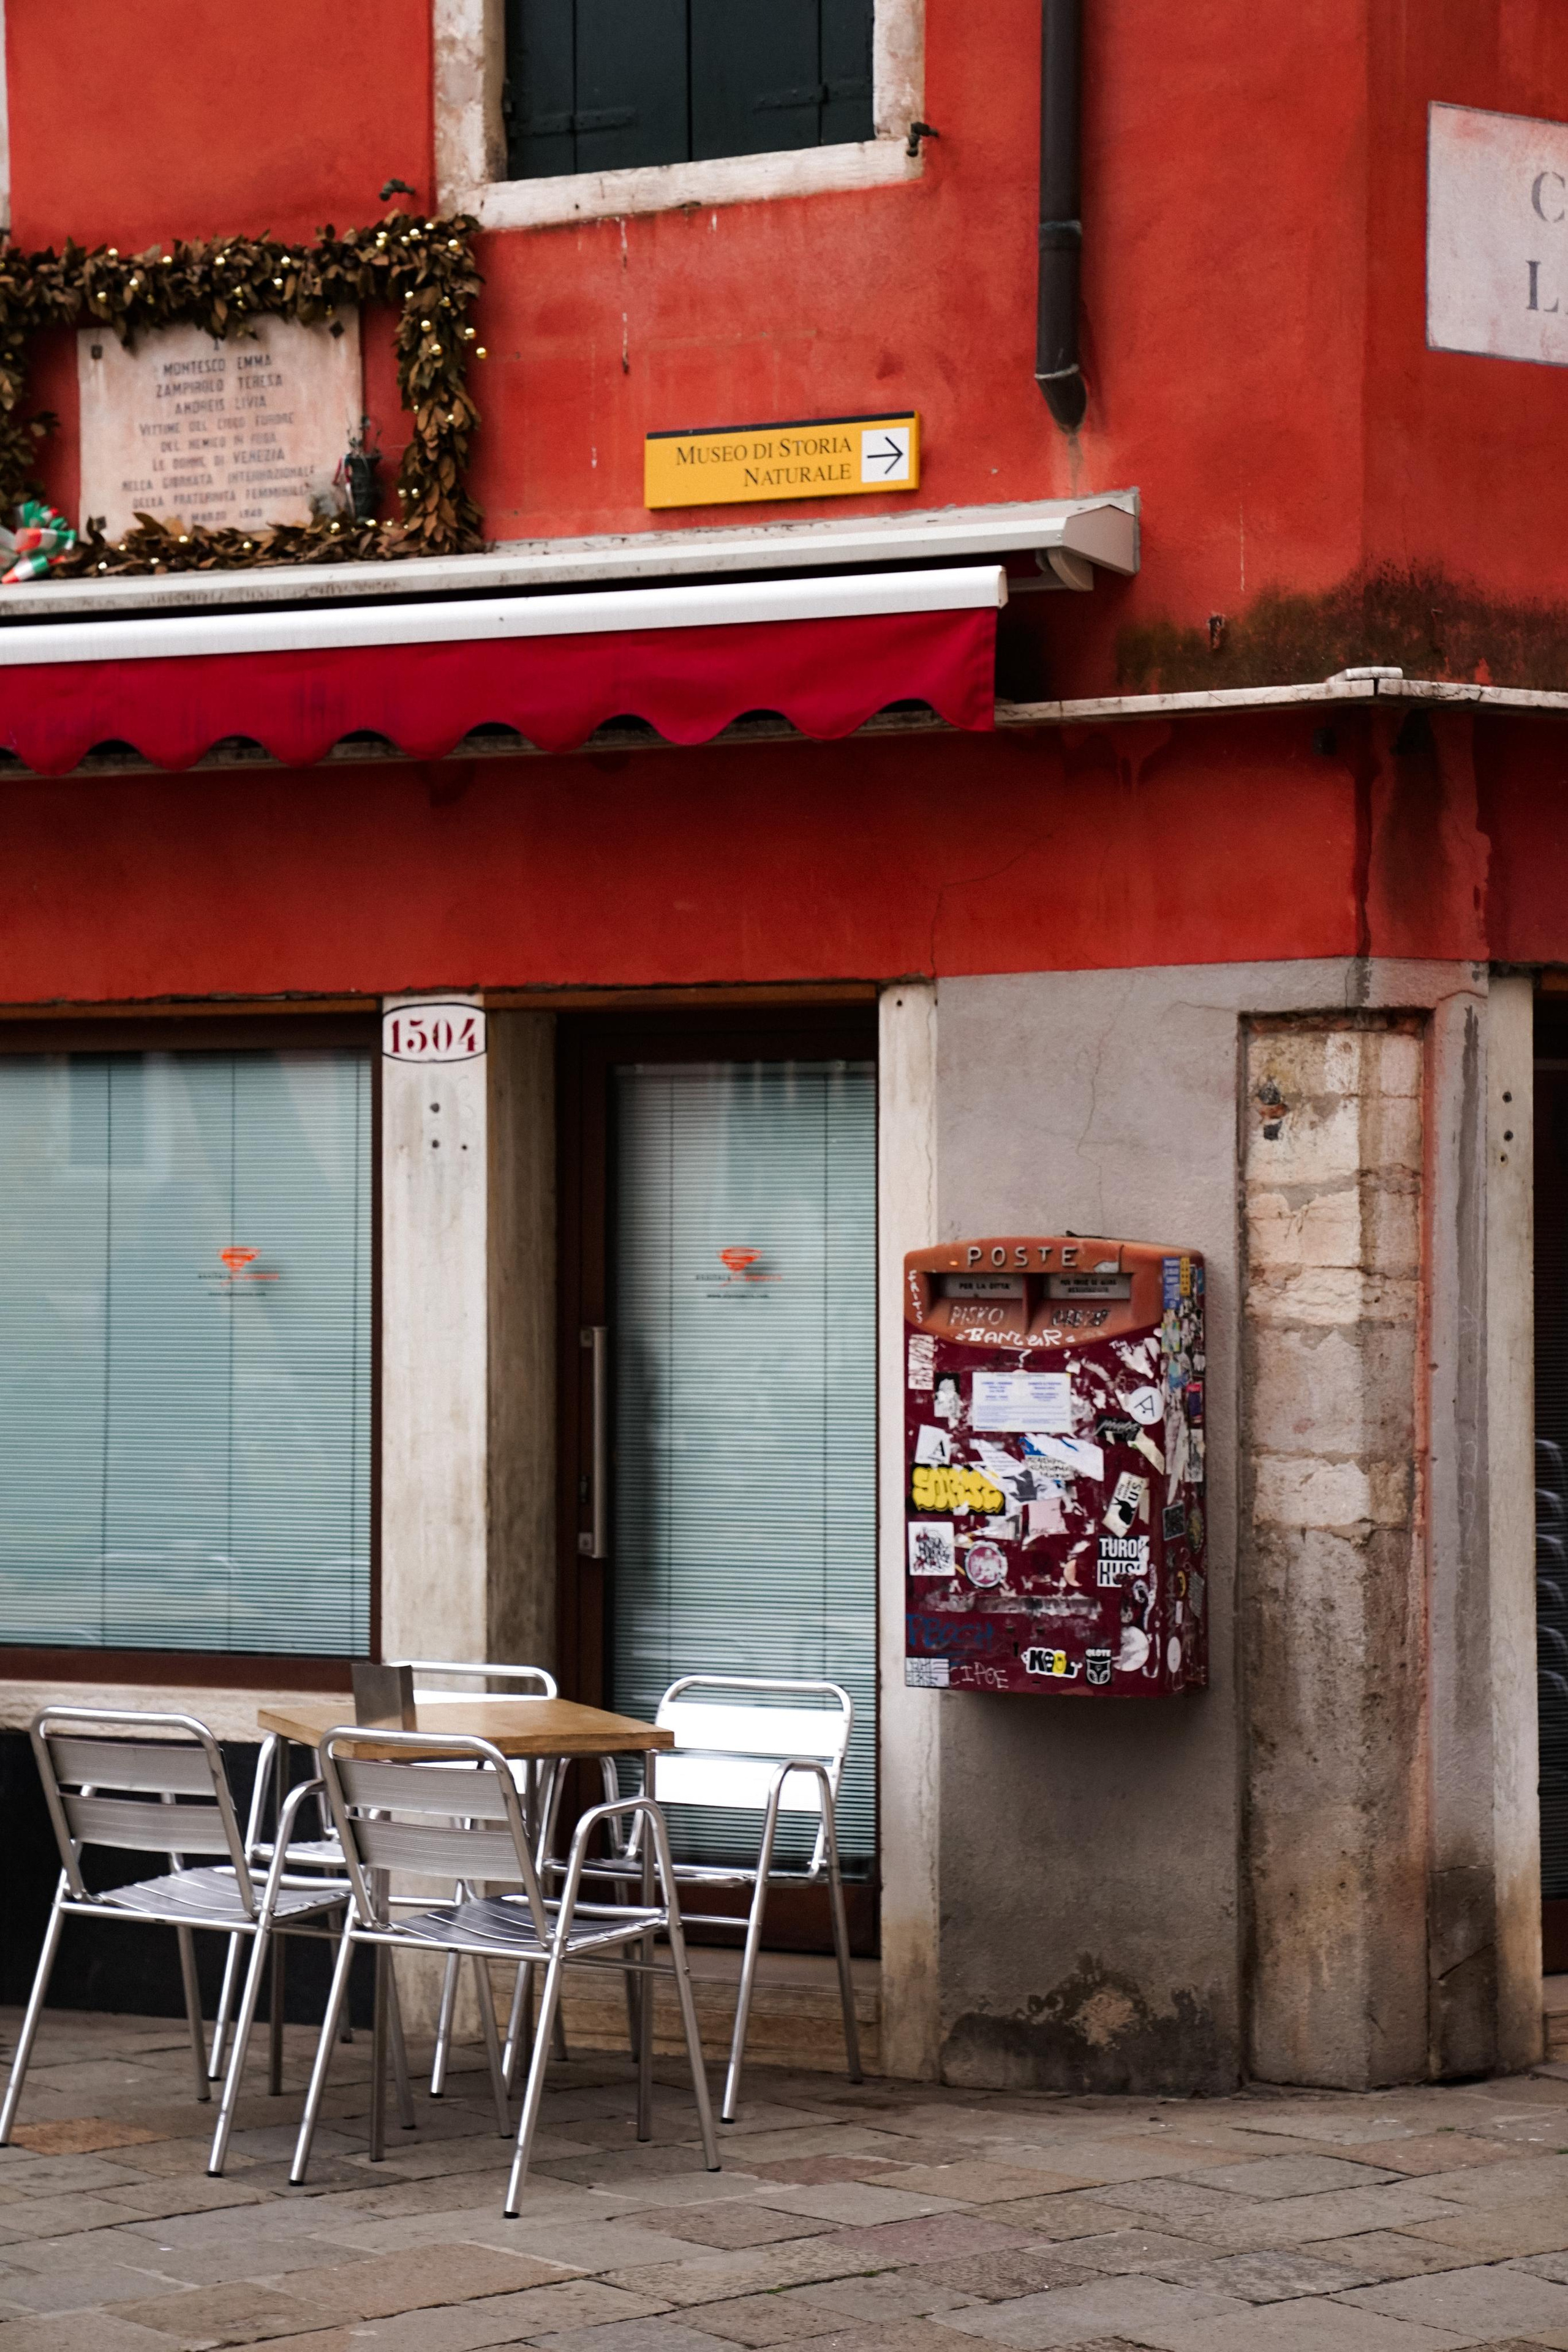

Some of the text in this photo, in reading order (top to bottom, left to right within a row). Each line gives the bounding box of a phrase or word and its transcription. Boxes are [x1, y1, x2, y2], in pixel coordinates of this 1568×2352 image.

[238, 354, 272, 370] EMMA
[238, 374, 282, 390] TERESA
[235, 395, 267, 410] LIVIA
[160, 440, 180, 453] DEL
[753, 442, 773, 460] DI
[778, 437, 853, 458] STORIA
[153, 458, 164, 472] LE
[233, 447, 285, 464] VENEZIA
[162, 473, 214, 489] GIORNATA
[743, 464, 853, 488] NATURALE
[391, 1018, 478, 1054] 1504
[967, 1246, 1079, 1267] POSTE
